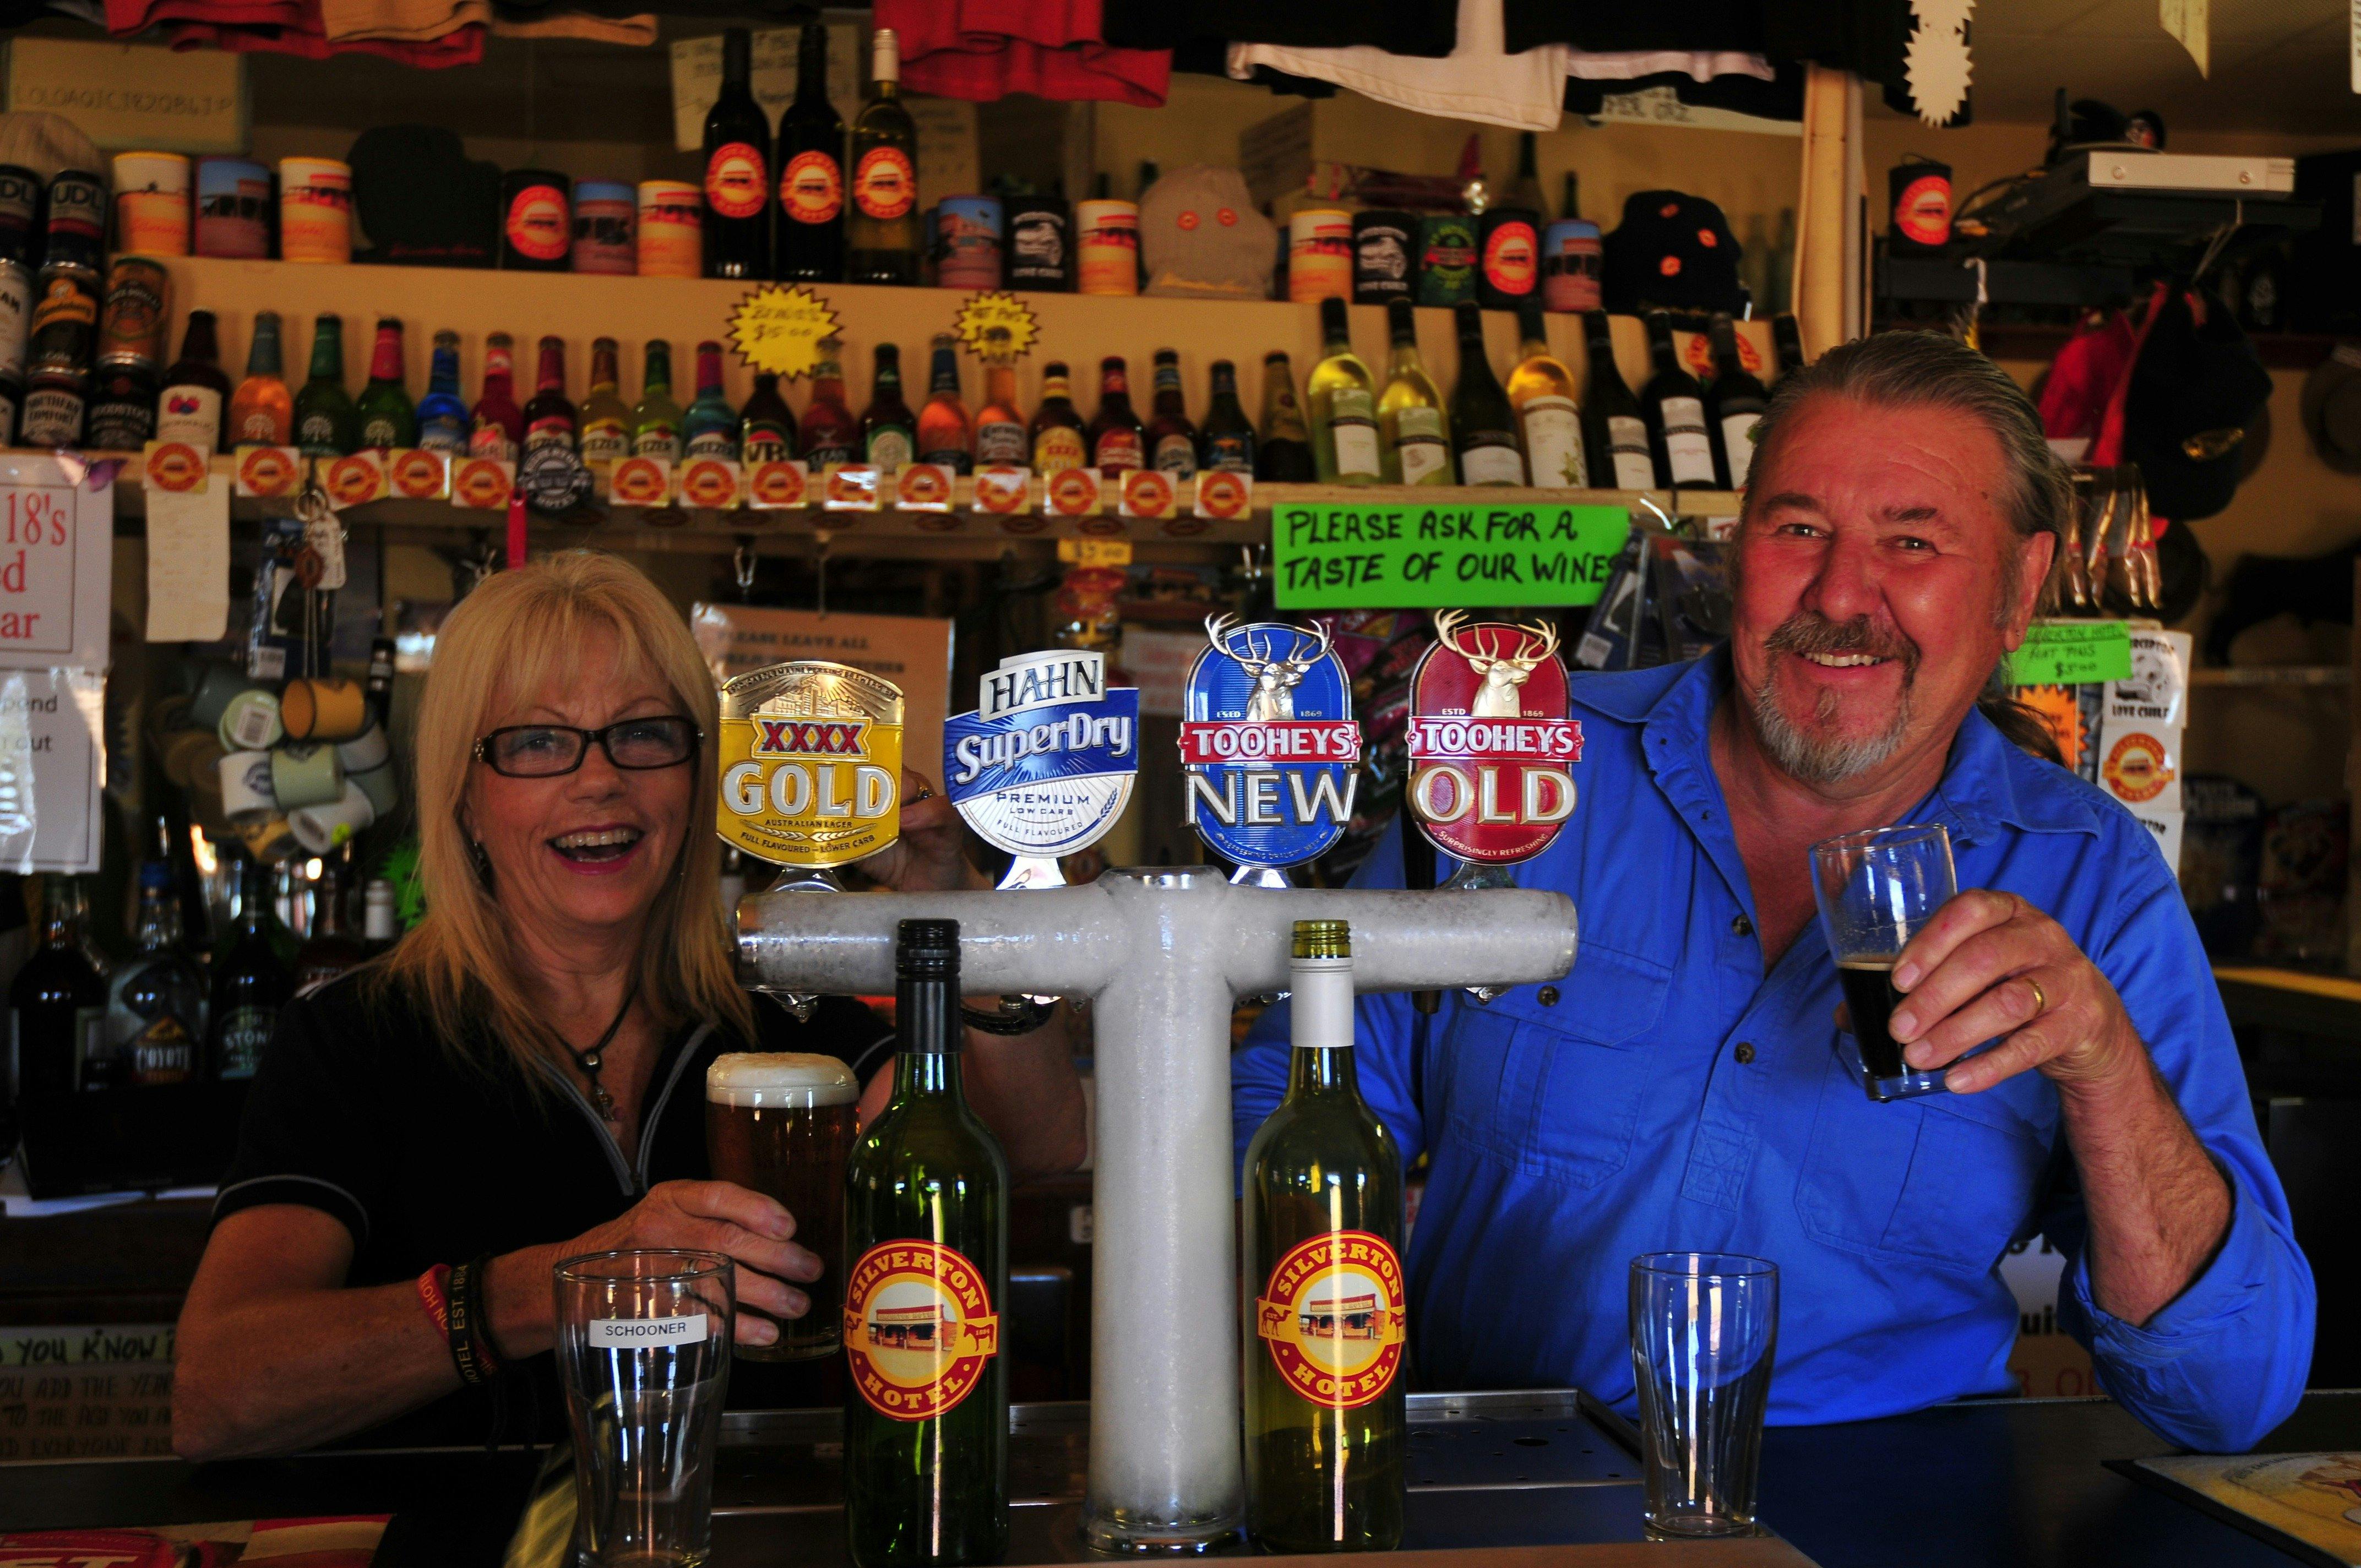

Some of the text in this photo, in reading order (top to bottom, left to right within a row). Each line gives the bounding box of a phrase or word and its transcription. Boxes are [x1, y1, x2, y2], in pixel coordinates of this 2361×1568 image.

[7, 493, 66, 547] 18's
[1285, 509, 1579, 547] PLEASE ASK FOR A
[1283, 553, 1385, 590] TASTE
[1402, 551, 1444, 584] OF
[1456, 552, 1524, 585] OUR
[0, 611, 41, 640] ar
[992, 659, 1098, 712] HAHN
[1441, 707, 1466, 716] ESTD
[761, 720, 861, 753] XXXX
[955, 712, 1132, 785] SuperDry
[1192, 726, 1352, 757] TOOHEYS
[1421, 723, 1574, 755] TOOHEYS
[722, 760, 897, 819] GOLD
[995, 792, 1090, 805] PREMIUM
[1183, 769, 1360, 829] NEW
[1406, 765, 1577, 826] OLD
[764, 819, 825, 827] AUSTRALIAN
[996, 819, 1084, 836] FULL FLAVOURED
[1040, 808, 1074, 816] CARB
[741, 831, 875, 853] FULL FLAVOURED LOWER CARB
[1438, 830, 1549, 857] SURPRISINGLY REFRESHING
[851, 1251, 981, 1310] SILVERTON
[1277, 1243, 1400, 1299] SILVERTON
[451, 1296, 466, 1331] EST.
[605, 1321, 687, 1337] SCHOONER
[15, 1338, 68, 1366] YOU
[82, 1328, 157, 1362] KNOW
[0, 1375, 24, 1400] OU
[34, 1376, 72, 1400] ADD
[82, 1375, 115, 1397] THE
[863, 1371, 965, 1410] HOTEL
[1292, 1362, 1390, 1397] HOTEL
[1, 1403, 28, 1427] TO
